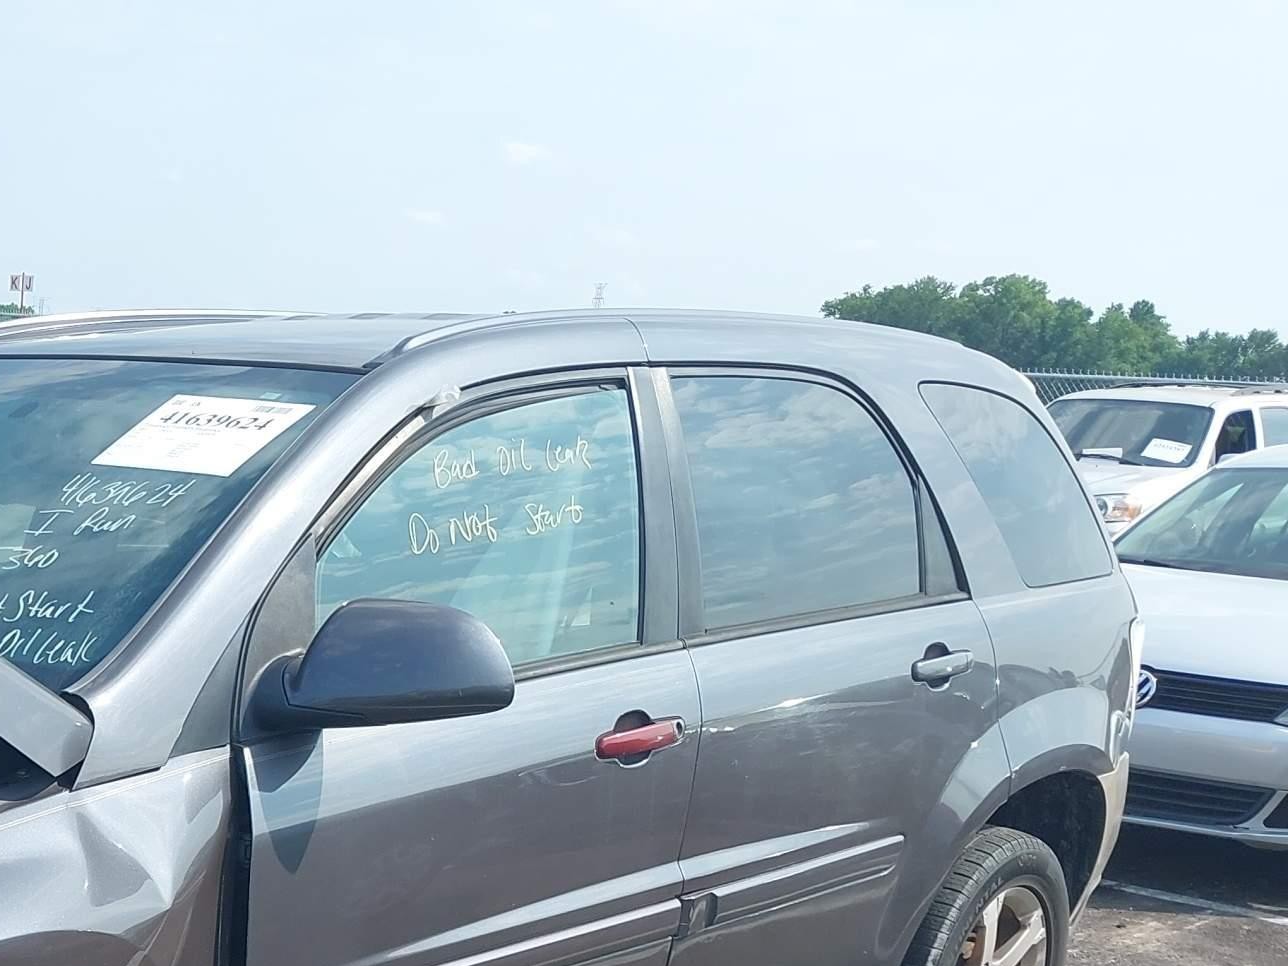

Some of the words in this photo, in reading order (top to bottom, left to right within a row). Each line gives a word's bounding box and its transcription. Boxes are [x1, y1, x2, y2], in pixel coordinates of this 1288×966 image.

[11, 275, 18, 290] K
[25, 276, 32, 290] J
[159, 411, 276, 431] 41639624
[433, 449, 480, 489] Bad
[408, 512, 440, 555] Do
[449, 504, 499, 546] Not
[523, 495, 584, 536] Start
[3, 589, 95, 623] Start
